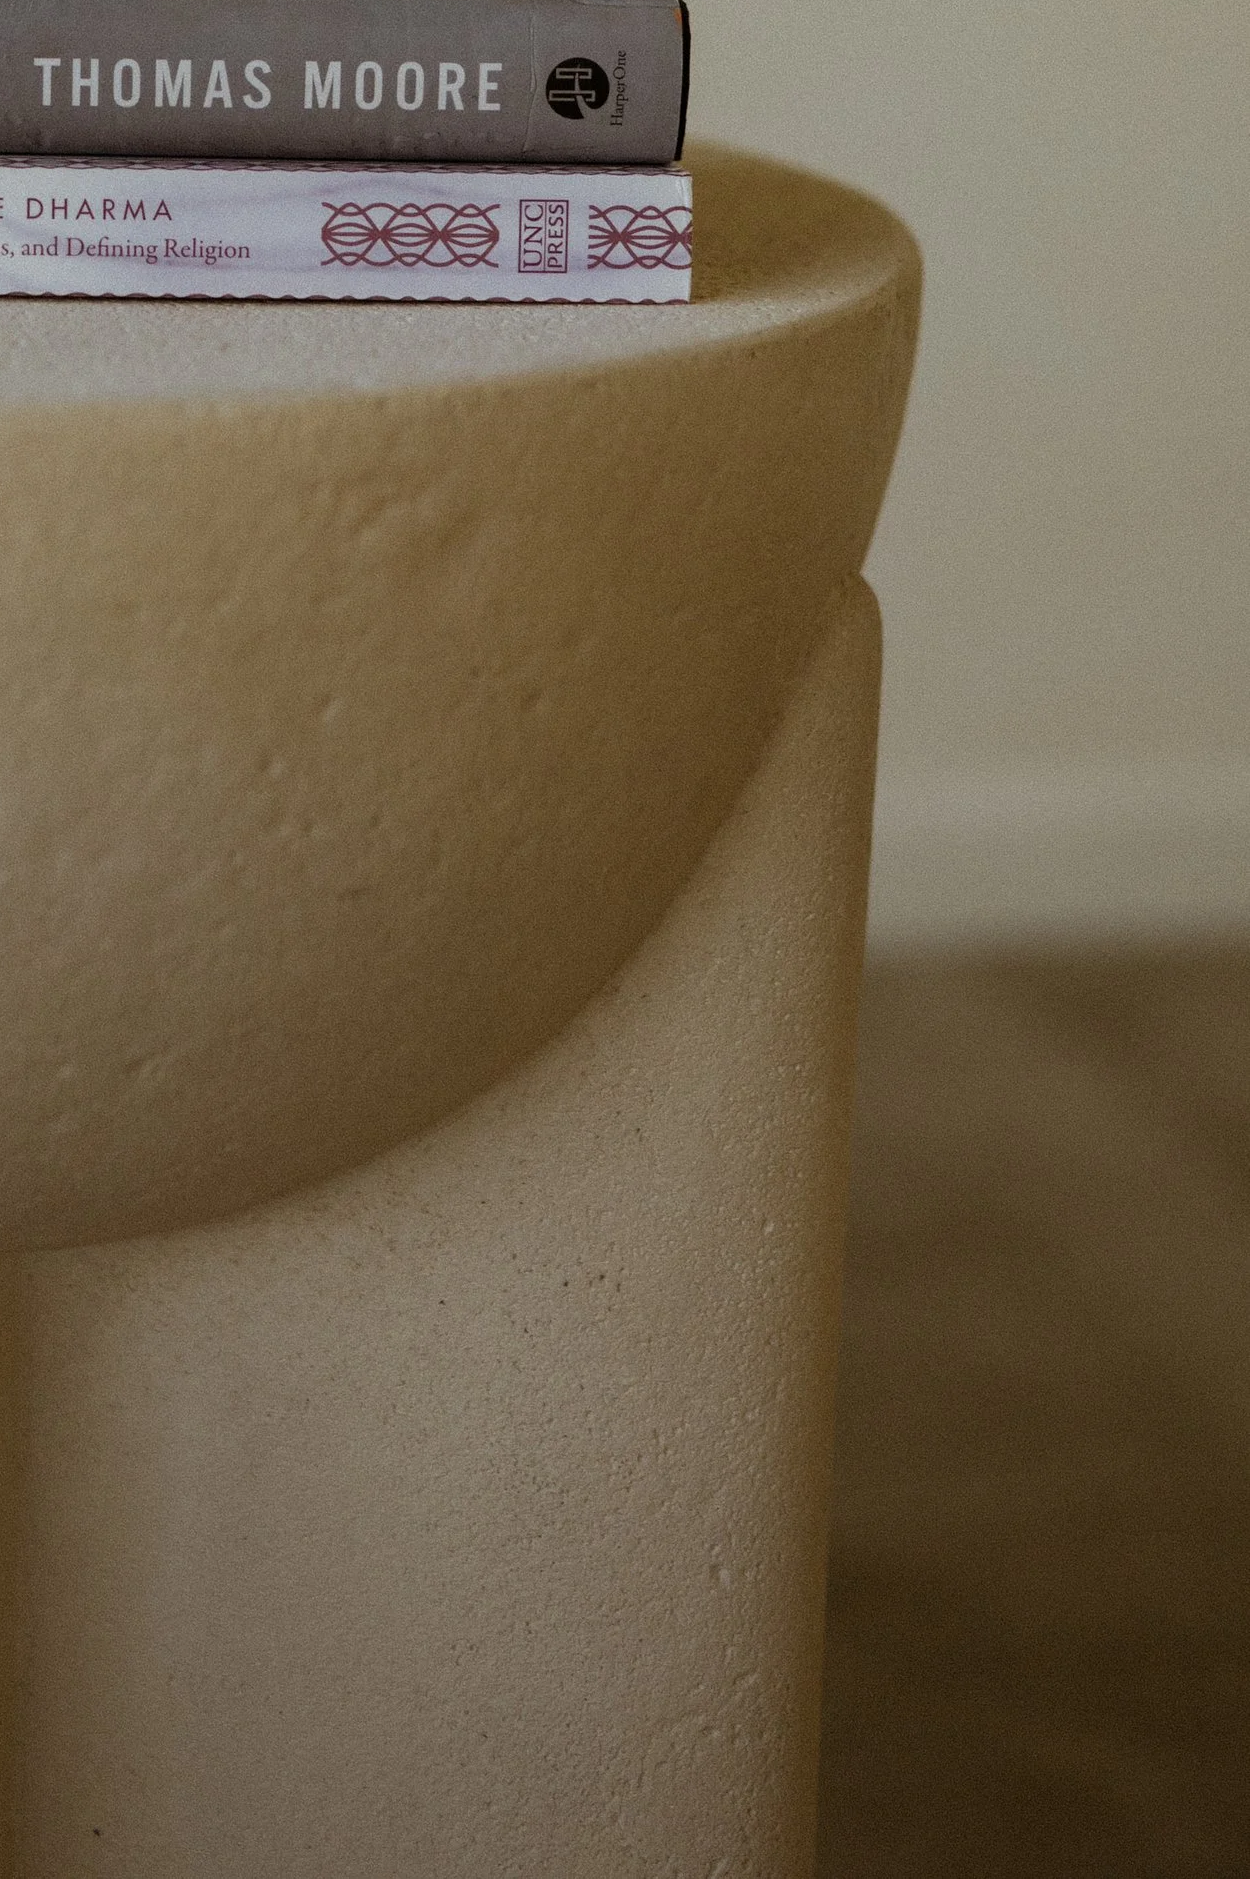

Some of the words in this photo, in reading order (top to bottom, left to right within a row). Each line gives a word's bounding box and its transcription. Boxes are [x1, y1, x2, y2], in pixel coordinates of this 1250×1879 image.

[34, 57, 272, 110] THOMAS
[303, 61, 503, 111] MOORE
[610, 50, 628, 126] HarperOne
[28, 198, 172, 221] DHARMA
[522, 203, 544, 268] UNC
[548, 203, 564, 268] PRESS
[21, 237, 58, 257] and
[66, 237, 158, 262] Defining
[163, 237, 250, 262] Religion
